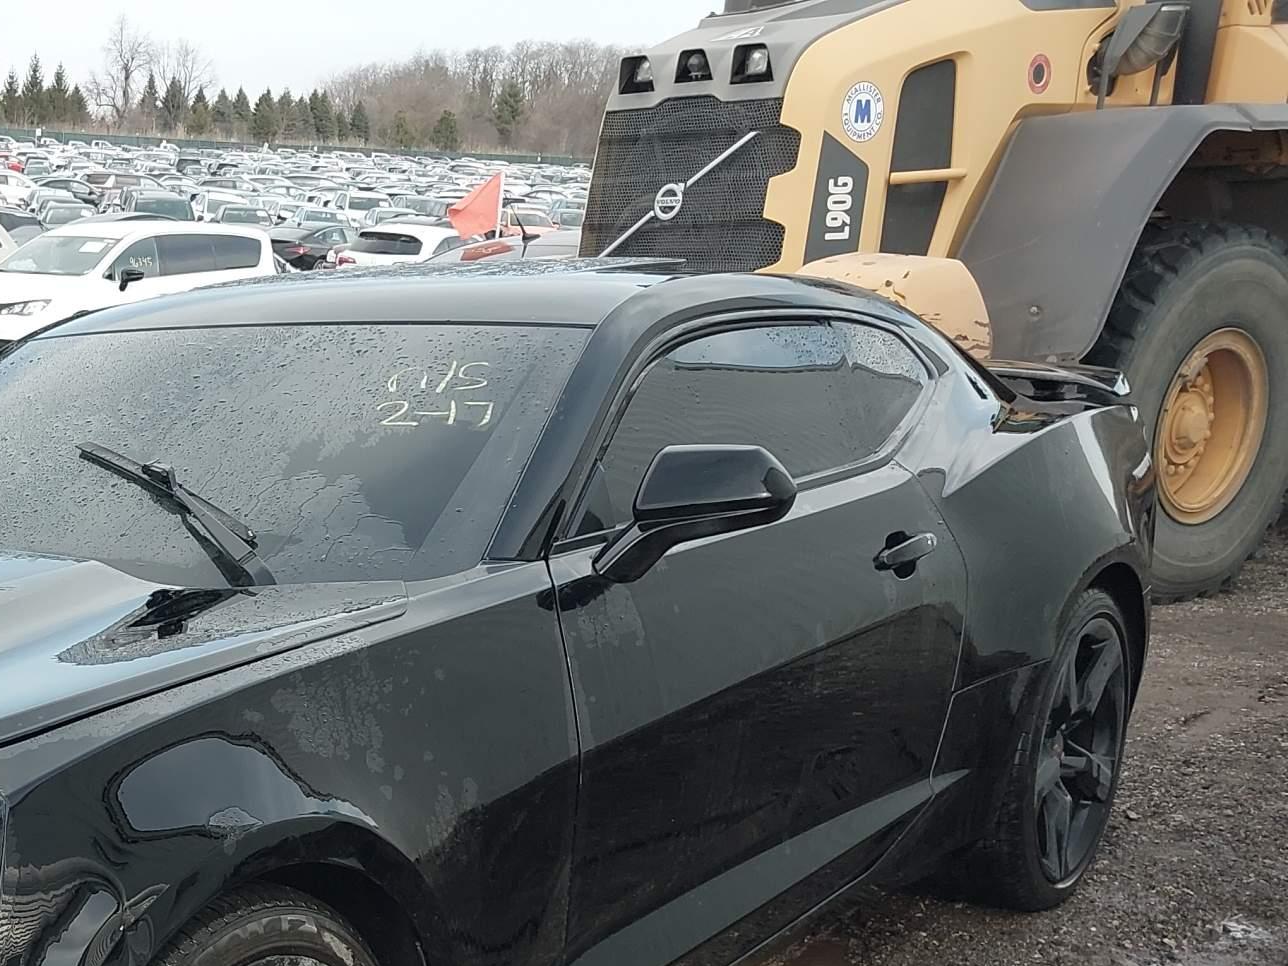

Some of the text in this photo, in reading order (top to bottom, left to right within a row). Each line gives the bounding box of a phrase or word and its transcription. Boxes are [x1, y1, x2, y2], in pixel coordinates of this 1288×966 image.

[854, 99, 871, 124] M
[843, 112, 876, 140] EQUIPMENT
[824, 176, 854, 241] L90G
